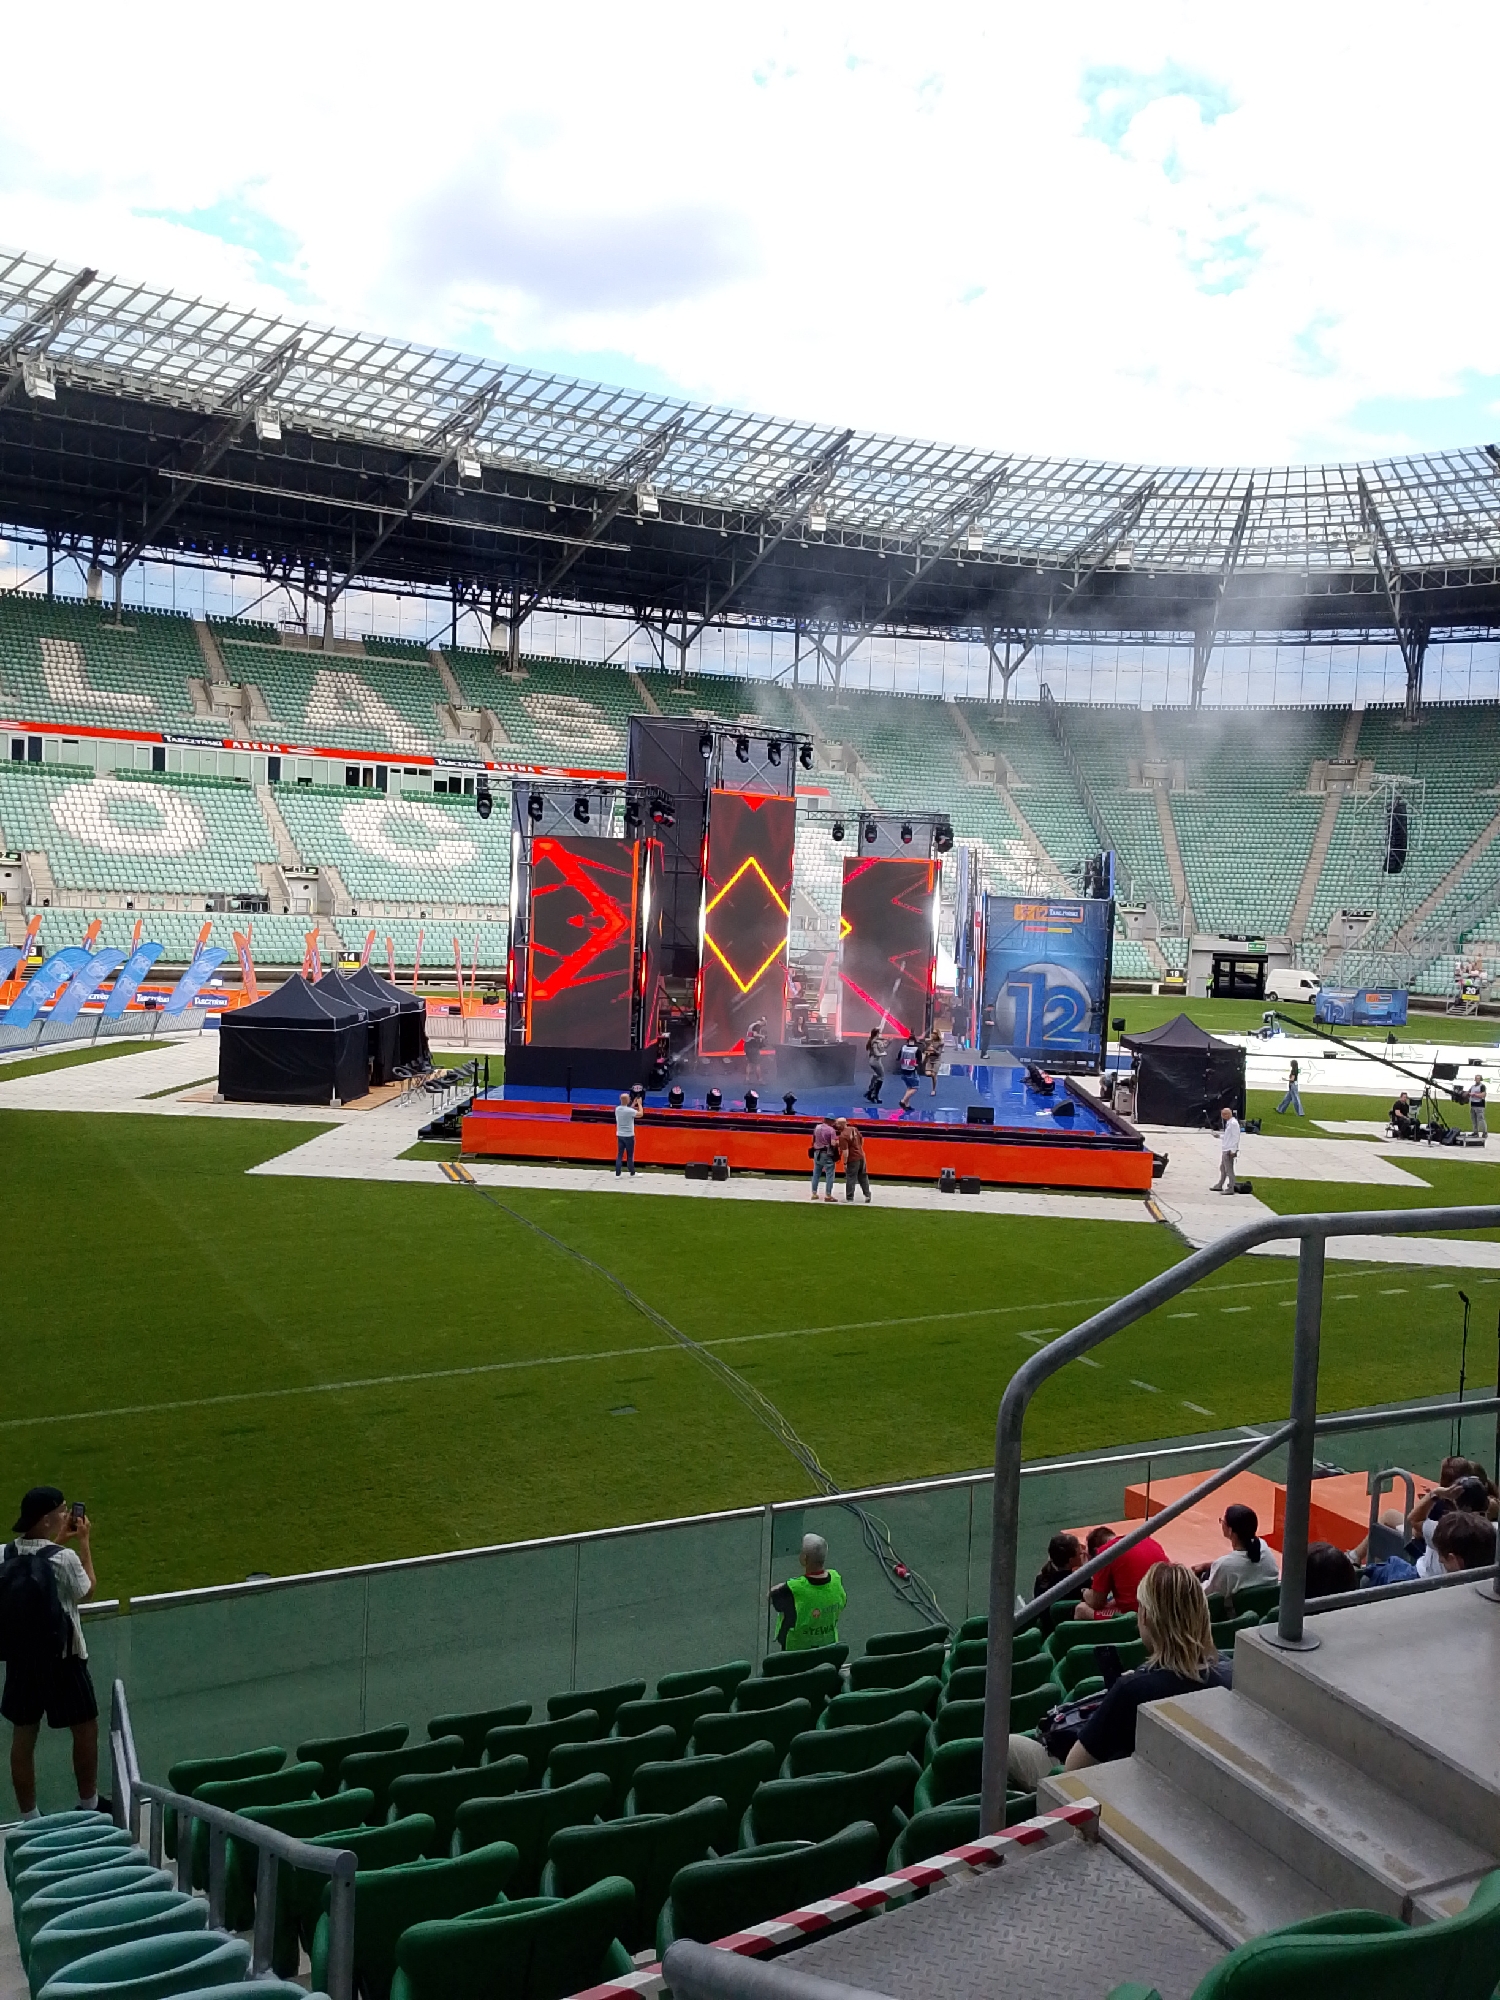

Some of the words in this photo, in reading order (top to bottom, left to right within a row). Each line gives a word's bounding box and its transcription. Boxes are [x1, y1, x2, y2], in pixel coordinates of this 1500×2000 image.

[232, 741, 281, 752] ARENA
[493, 763, 536, 773] ARENA
[342, 952, 355, 962] 14
[1465, 986, 1476, 995] 20
[1007, 971, 1090, 1050] 12
[803, 1624, 835, 1636] STEWA
